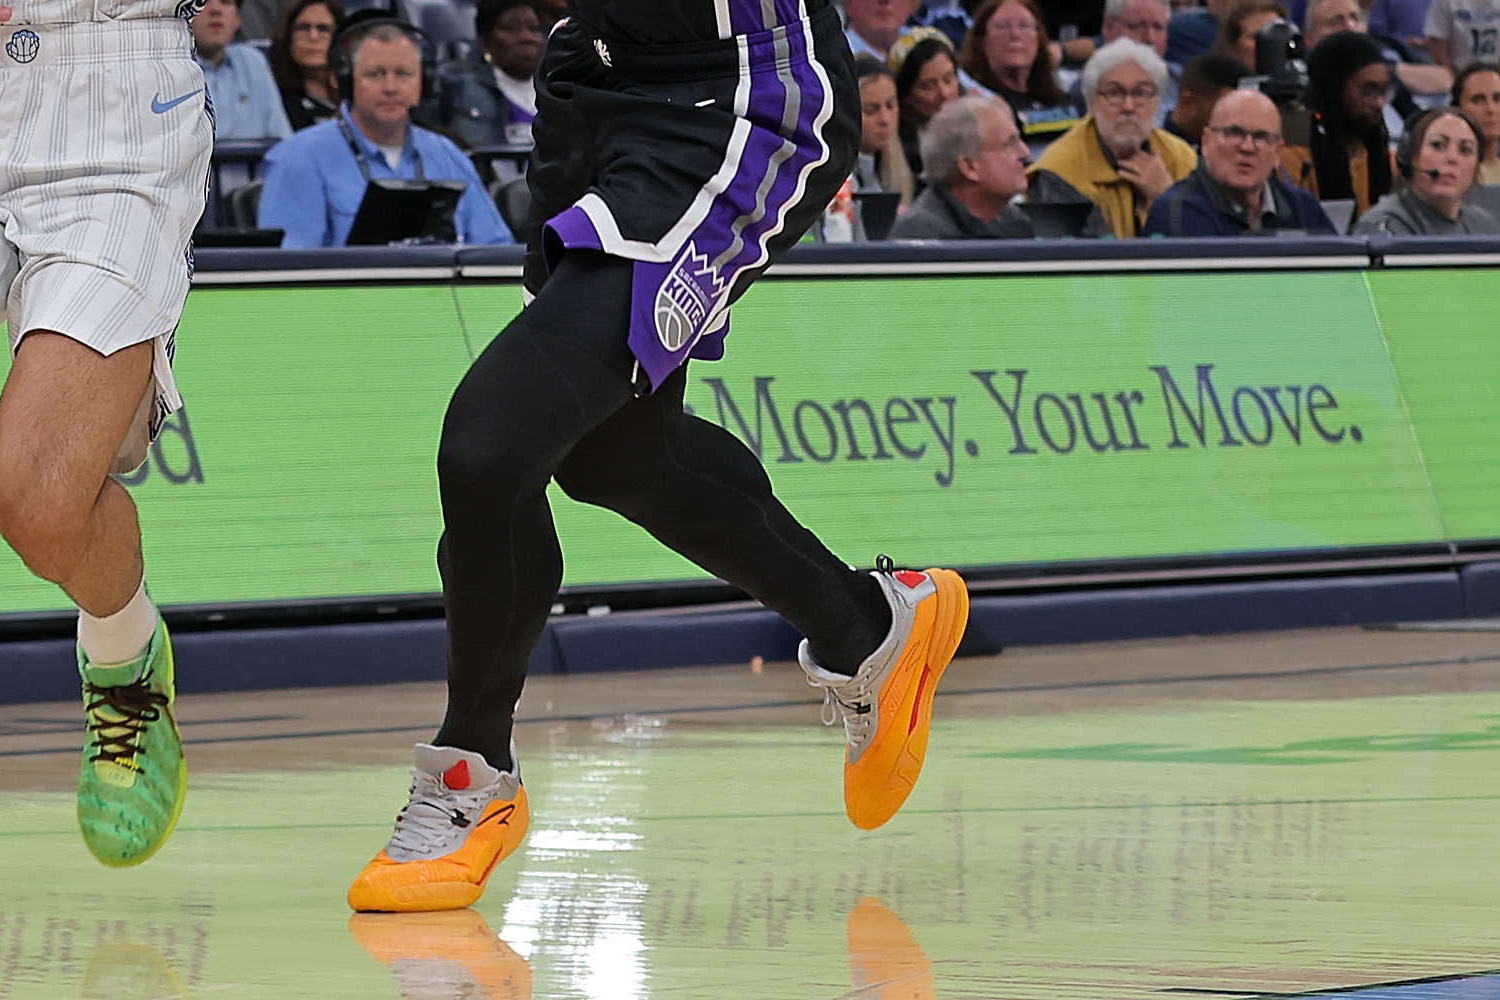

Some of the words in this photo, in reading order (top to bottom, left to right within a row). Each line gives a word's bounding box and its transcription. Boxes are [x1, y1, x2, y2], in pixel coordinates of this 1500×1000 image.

[700, 375, 979, 487] Money.
[970, 368, 1150, 455] Your
[1148, 363, 1364, 448] Move.
